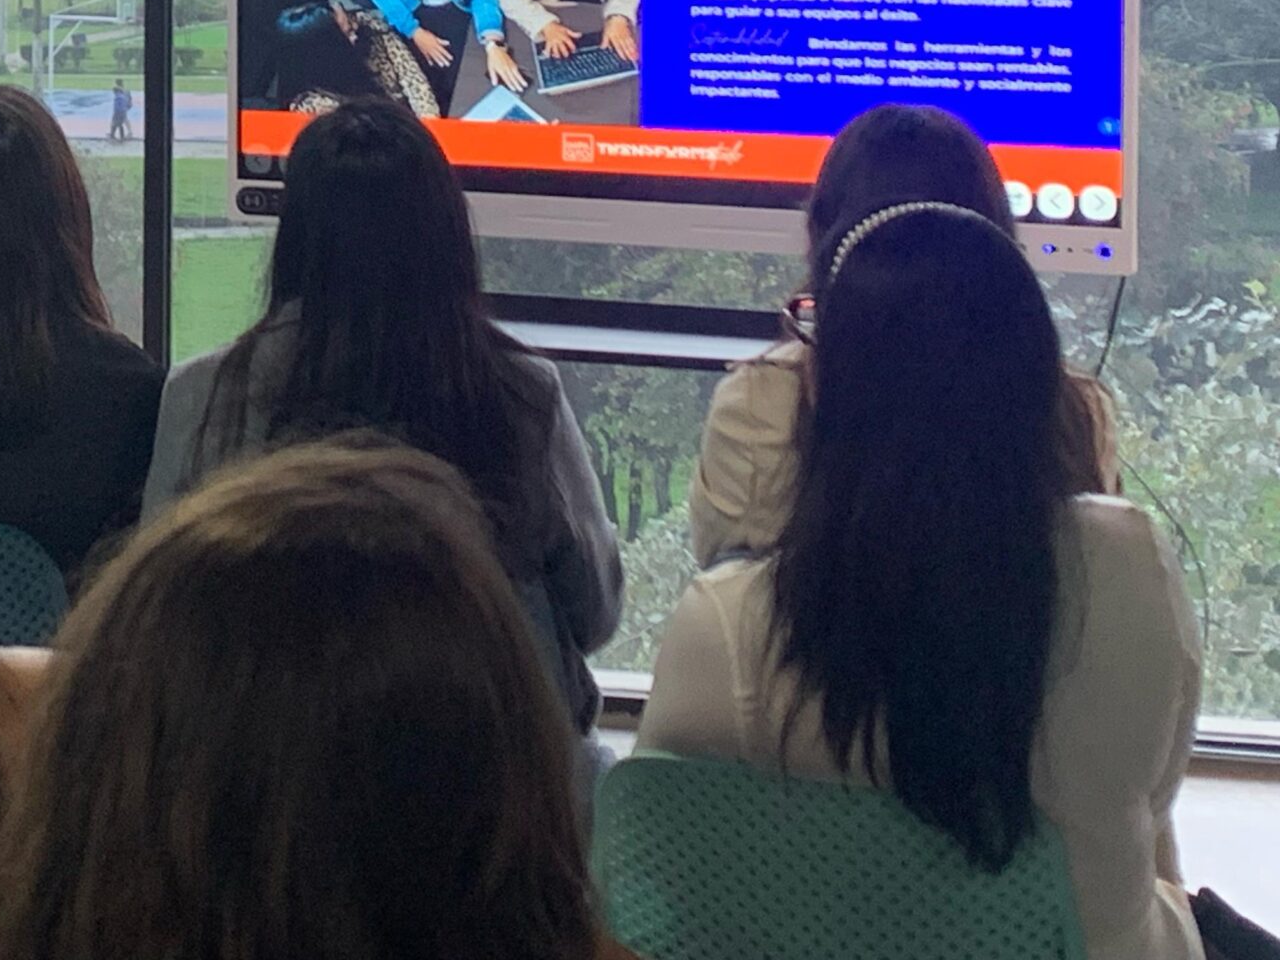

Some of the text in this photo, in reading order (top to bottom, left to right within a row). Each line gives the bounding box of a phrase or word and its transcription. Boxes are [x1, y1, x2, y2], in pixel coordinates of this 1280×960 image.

[690, 6, 723, 17] para
[724, 5, 763, 18] guiar
[764, 8, 775, 17] a
[776, 8, 801, 18] sus
[802, 7, 861, 20] equipos
[862, 8, 878, 20] al
[808, 37, 888, 51] Brindamos
[894, 40, 917, 53] las
[923, 41, 1025, 55] herramientas
[1031, 47, 1042, 59] y
[1048, 44, 1072, 57] los
[690, 52, 795, 66] conocimientos
[796, 56, 830, 67] para
[832, 57, 862, 69] que
[888, 58, 956, 72] negocios
[690, 69, 782, 82] responsables
[784, 72, 813, 83] con
[835, 73, 884, 85] medio
[887, 75, 961, 88] ambiente
[963, 79, 975, 91] y
[978, 78, 1072, 93] socialmente
